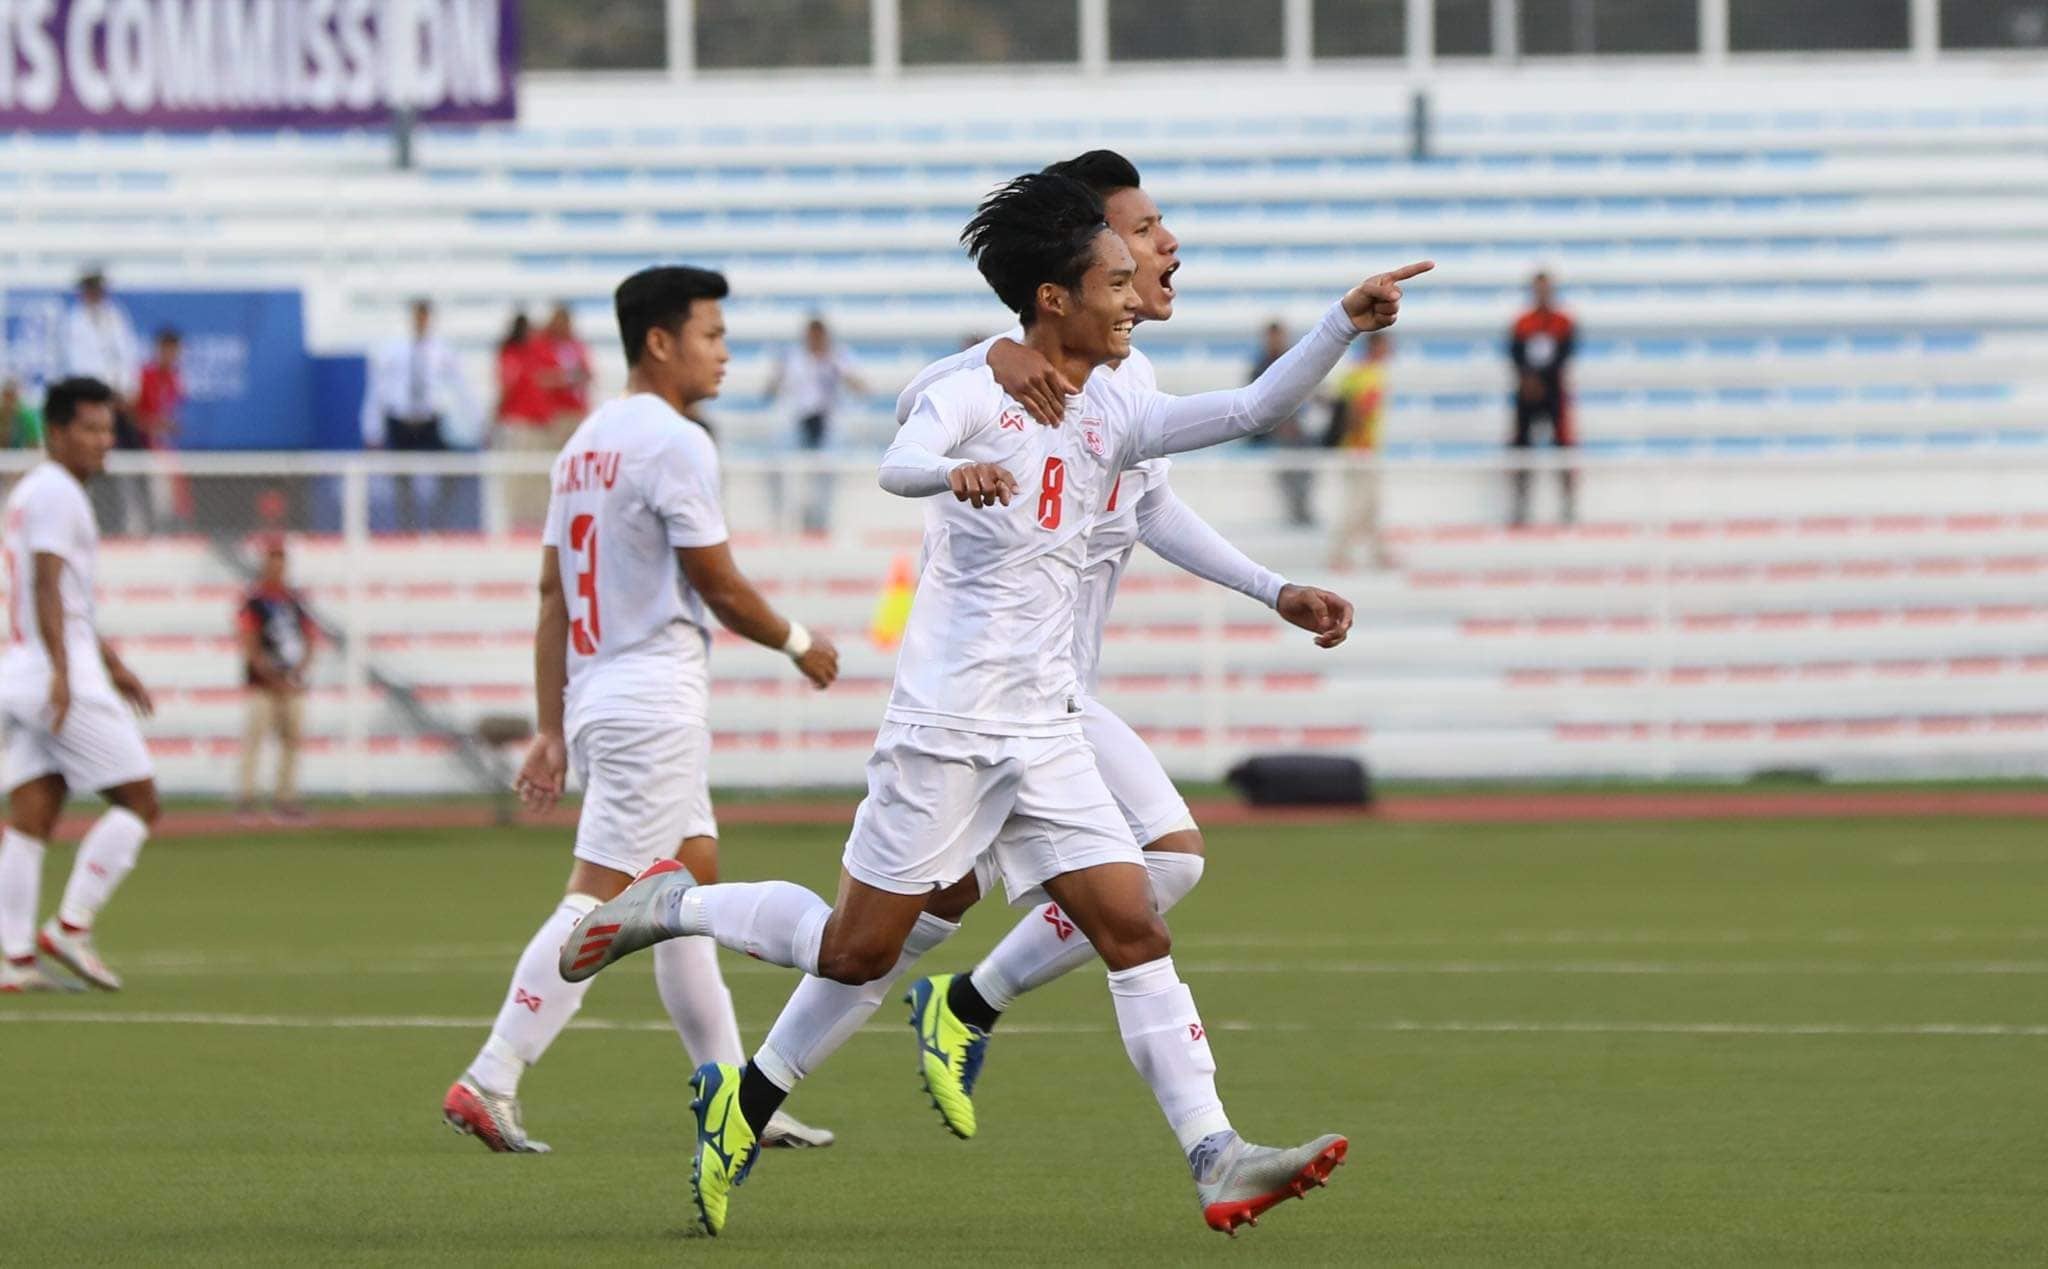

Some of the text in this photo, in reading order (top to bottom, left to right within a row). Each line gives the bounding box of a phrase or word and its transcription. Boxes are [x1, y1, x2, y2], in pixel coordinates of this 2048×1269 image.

[67, 0, 500, 112] COMMISSION
[1037, 456, 1064, 531] 8
[569, 514, 601, 656] 3
